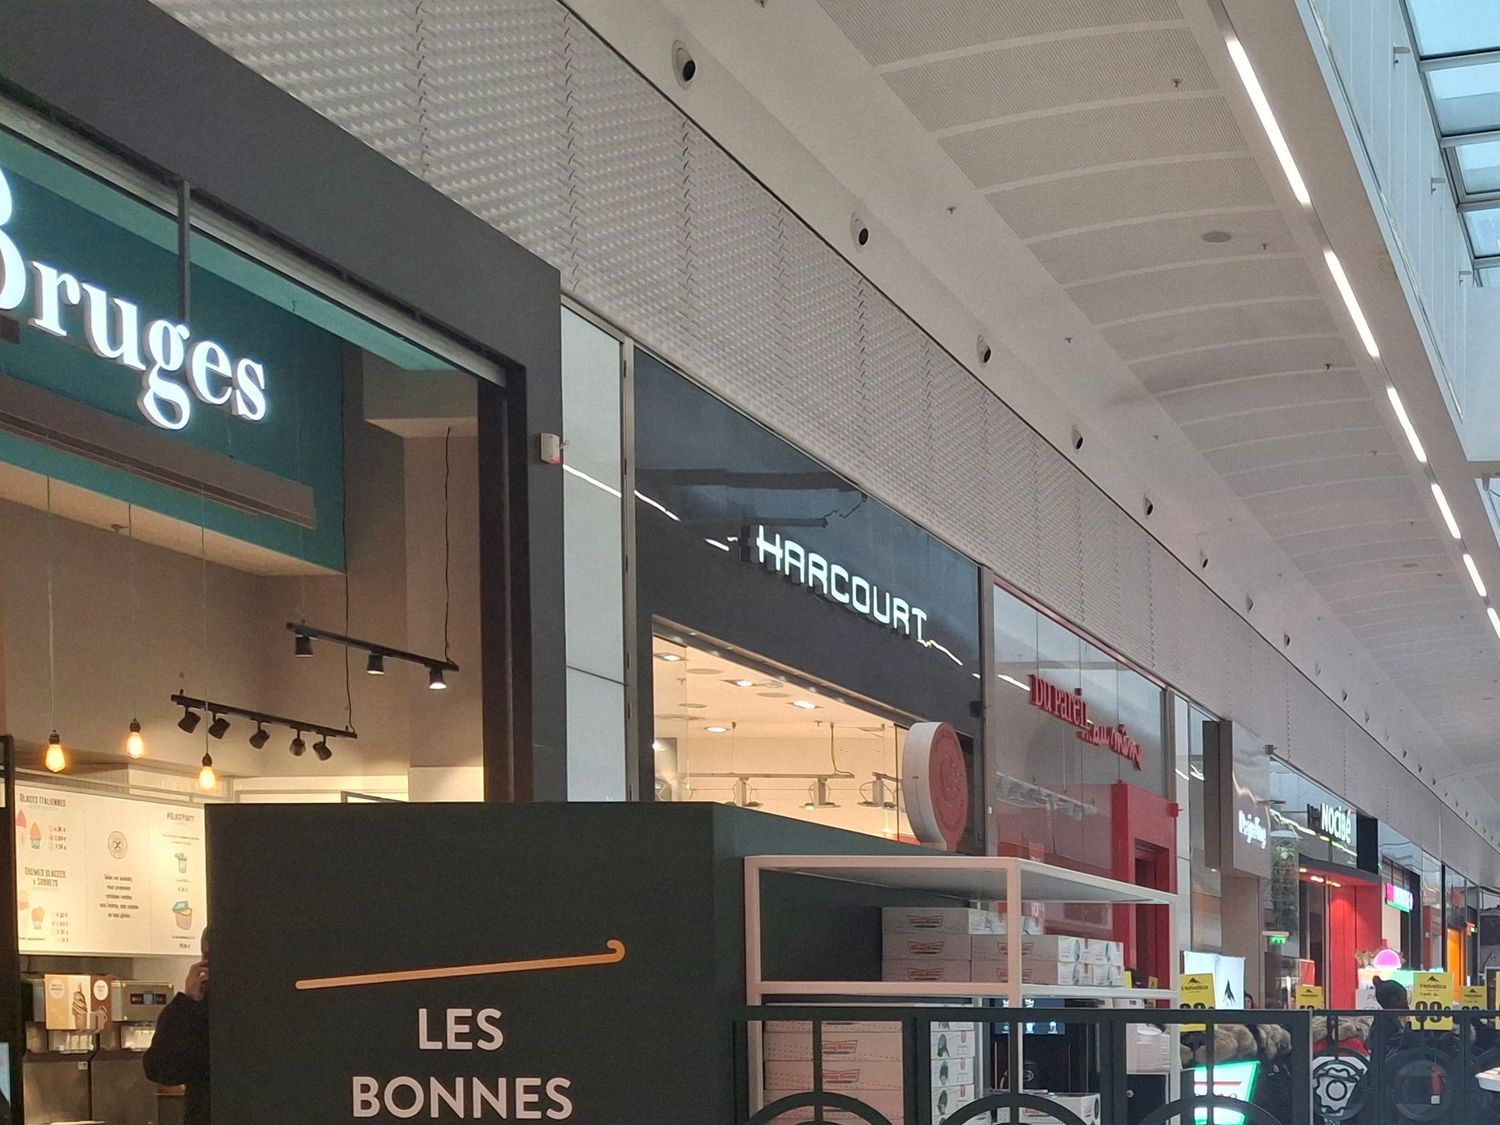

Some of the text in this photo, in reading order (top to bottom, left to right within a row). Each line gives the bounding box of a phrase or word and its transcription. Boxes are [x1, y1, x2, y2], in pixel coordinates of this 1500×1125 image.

[756, 525, 928, 641] HARCOURT
[418, 1008, 504, 1051] LES
[352, 1076, 573, 1120] BONNES
